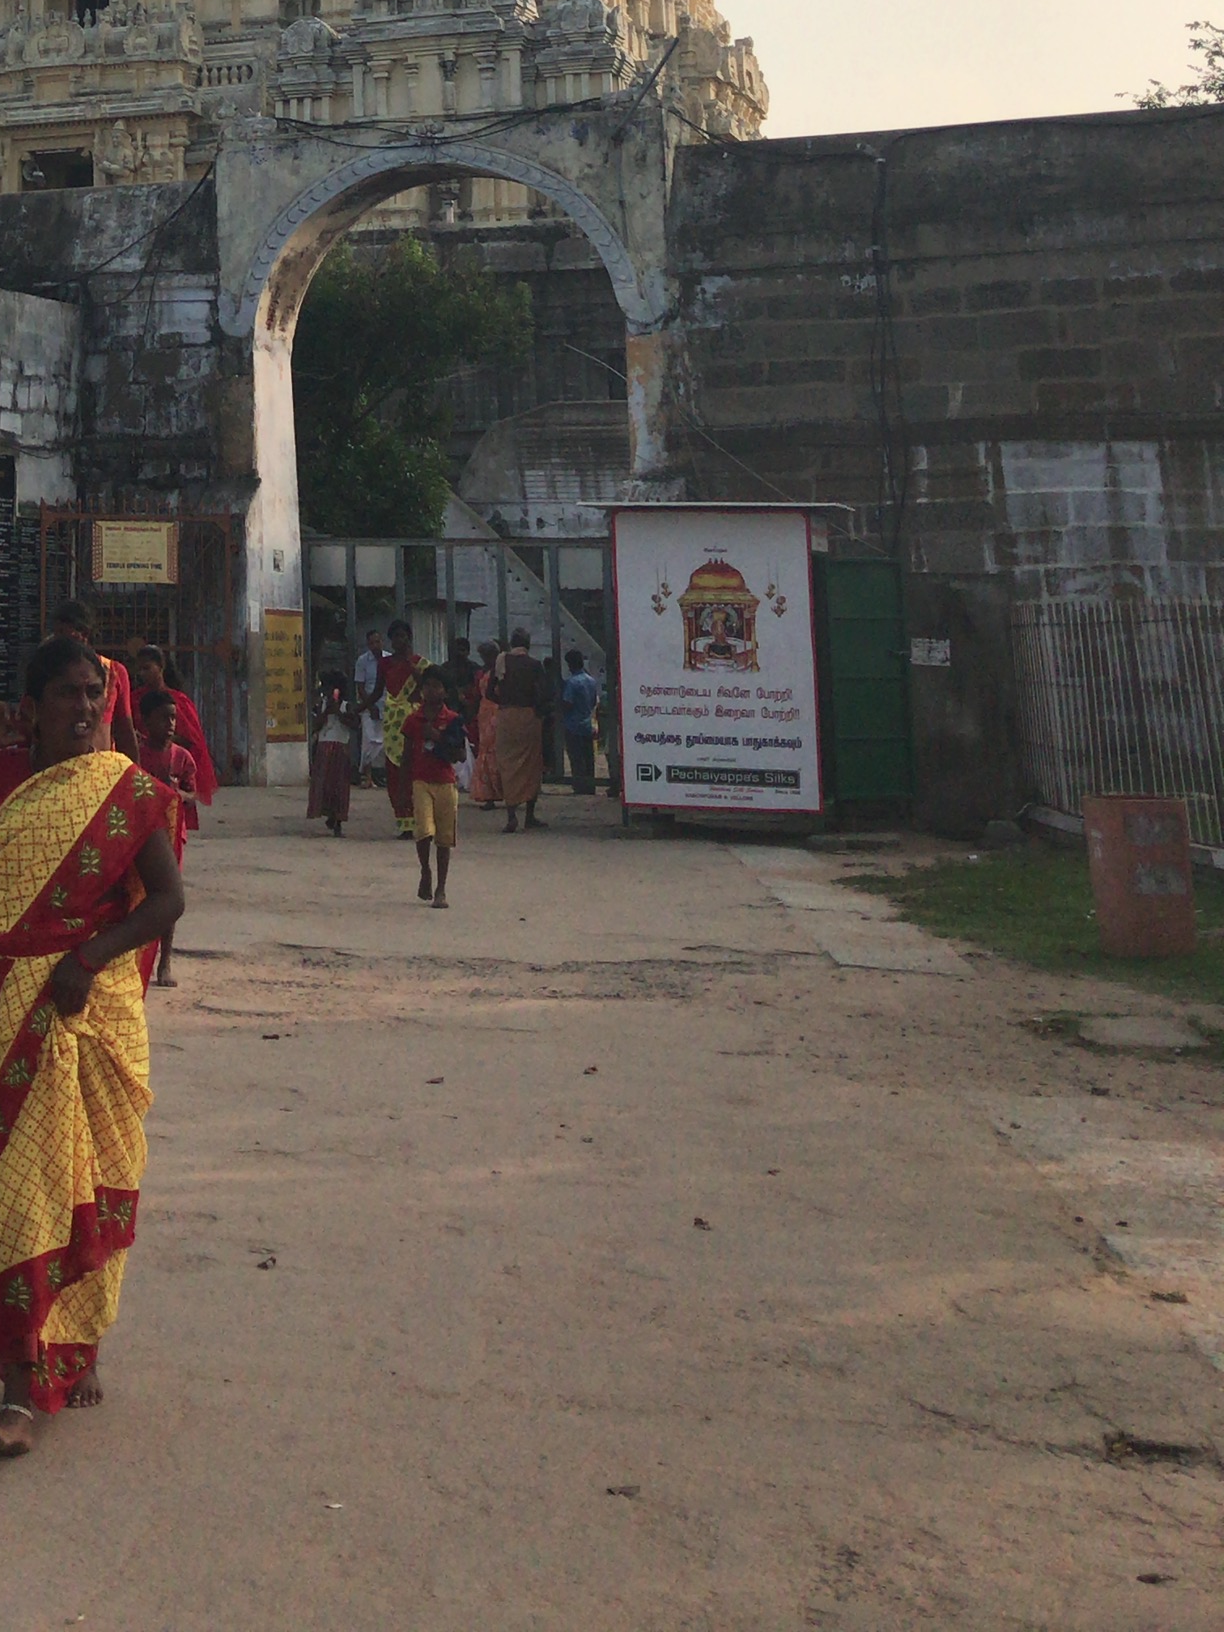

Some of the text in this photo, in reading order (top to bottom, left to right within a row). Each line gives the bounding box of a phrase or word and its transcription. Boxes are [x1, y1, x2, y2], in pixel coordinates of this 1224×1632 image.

[717, 686, 751, 699] சிவனே
[715, 705, 755, 721] இறைவா
[634, 731, 682, 746] ஆலயத்தை
[686, 733, 739, 748] தூய்மையாக
[671, 768, 796, 785] Pachaiyappa's Silks
